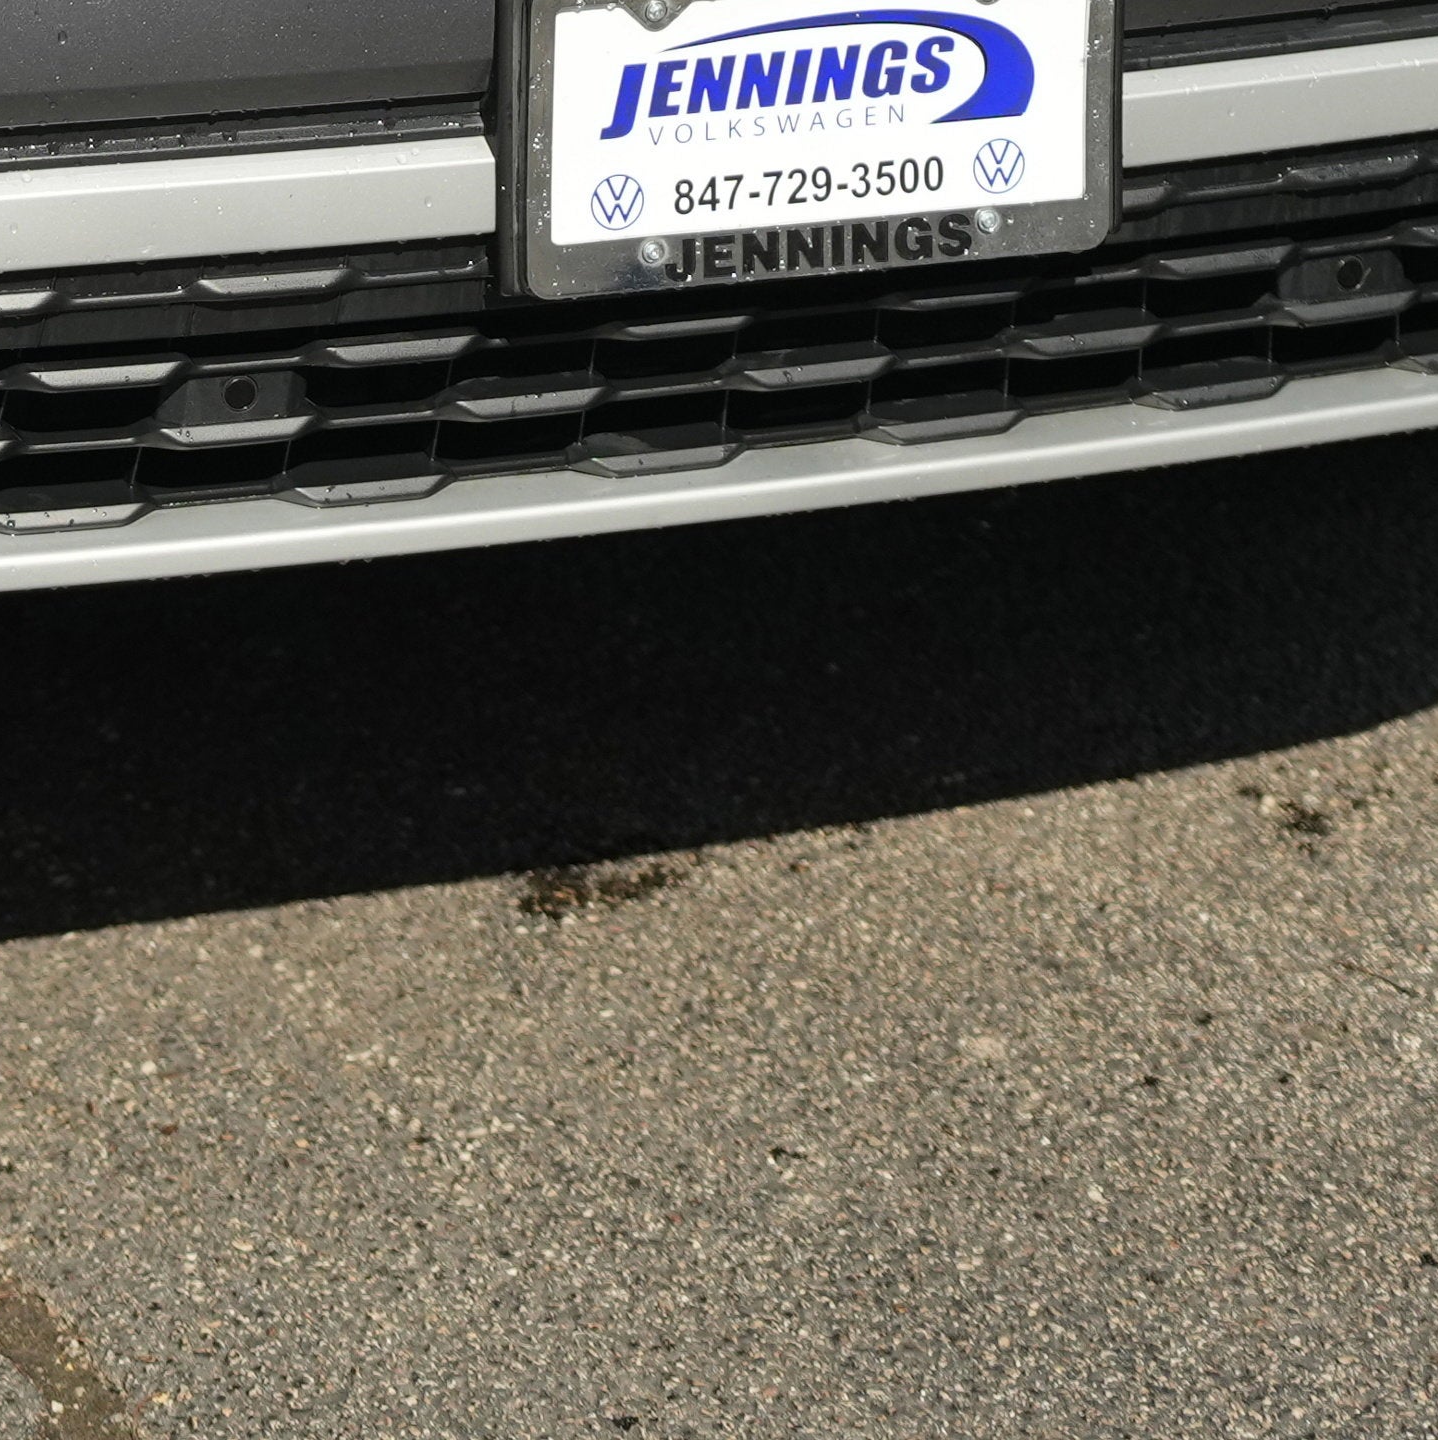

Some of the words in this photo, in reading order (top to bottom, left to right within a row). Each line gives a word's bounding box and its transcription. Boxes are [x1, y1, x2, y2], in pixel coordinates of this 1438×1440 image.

[599, 35, 956, 141] JENNINGS
[649, 103, 906, 146] VOLKSWAGEN
[674, 155, 944, 215] 847-729-3500
[665, 212, 974, 283] JENNINGS
